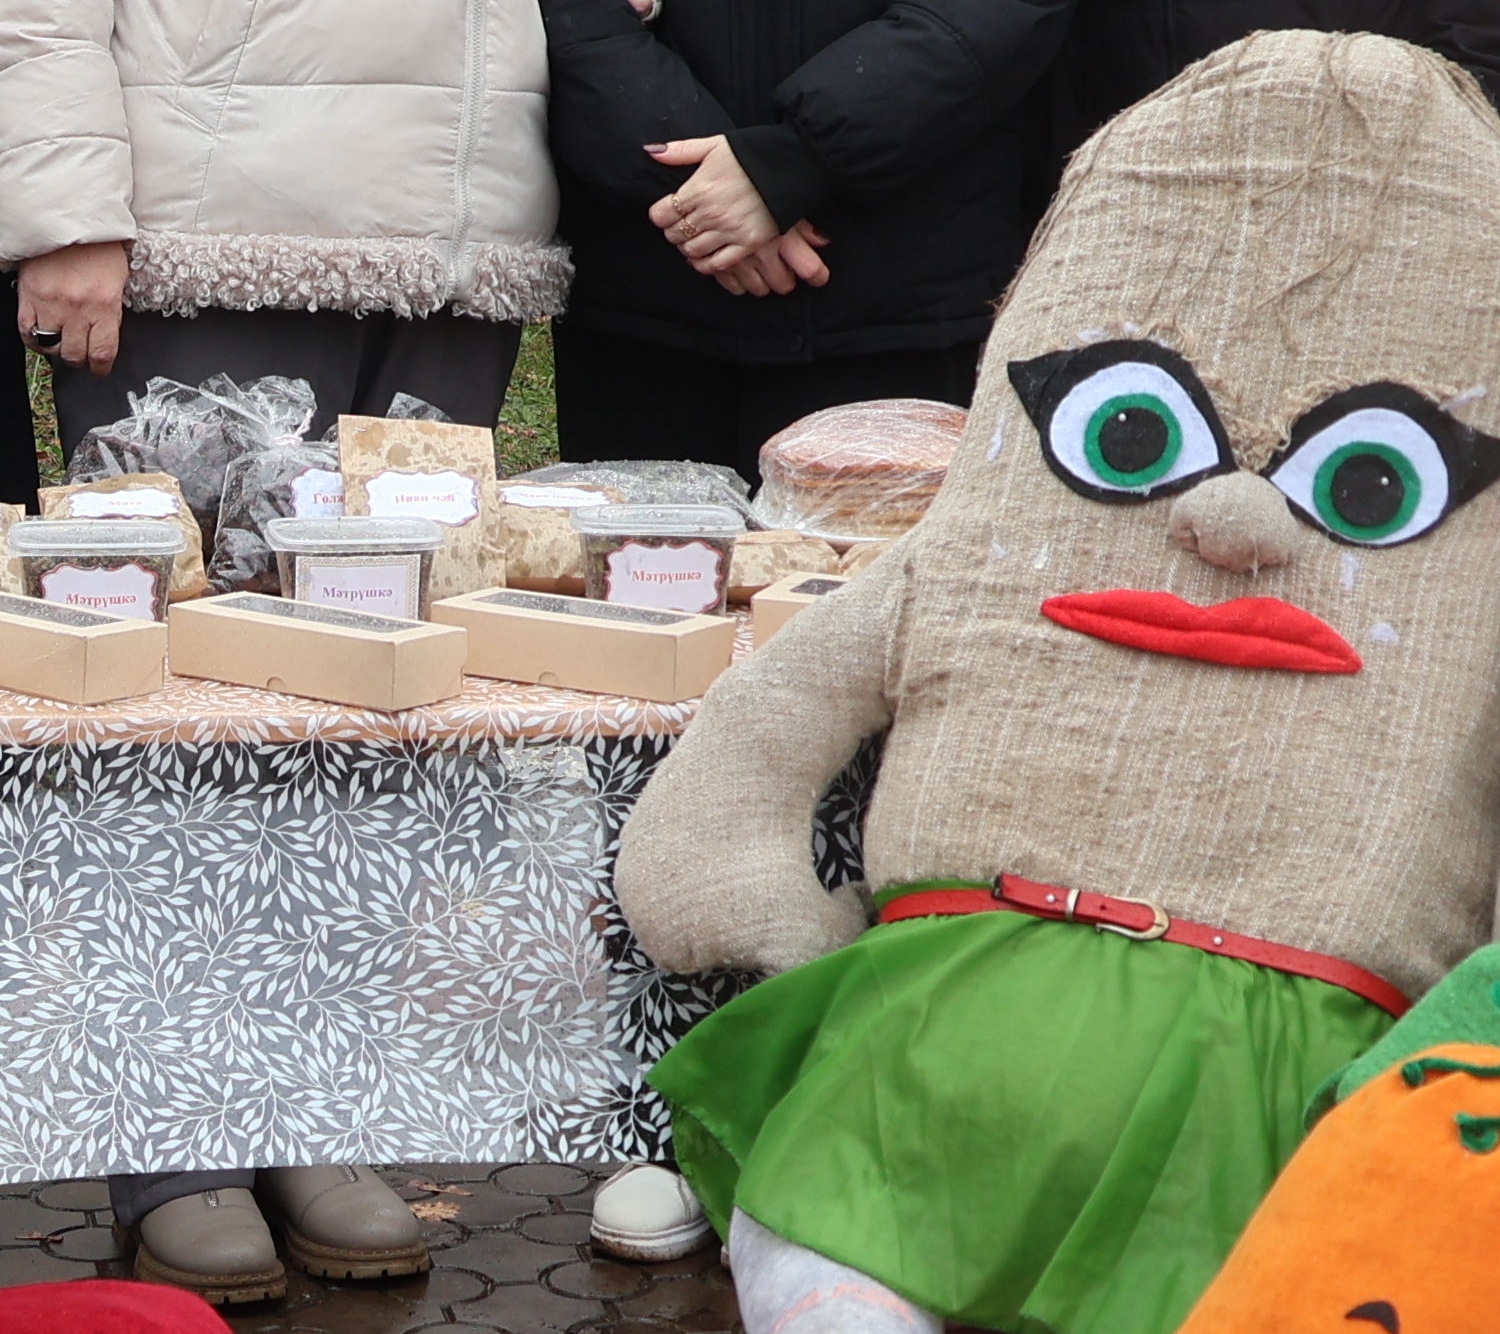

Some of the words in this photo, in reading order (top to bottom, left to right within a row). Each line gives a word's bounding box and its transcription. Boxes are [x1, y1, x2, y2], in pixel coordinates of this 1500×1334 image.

[631, 569, 702, 585] Мәтрүшкә
[65, 592, 137, 608] Мәтрүшкә
[322, 586, 393, 601] Мәтрүшкә
